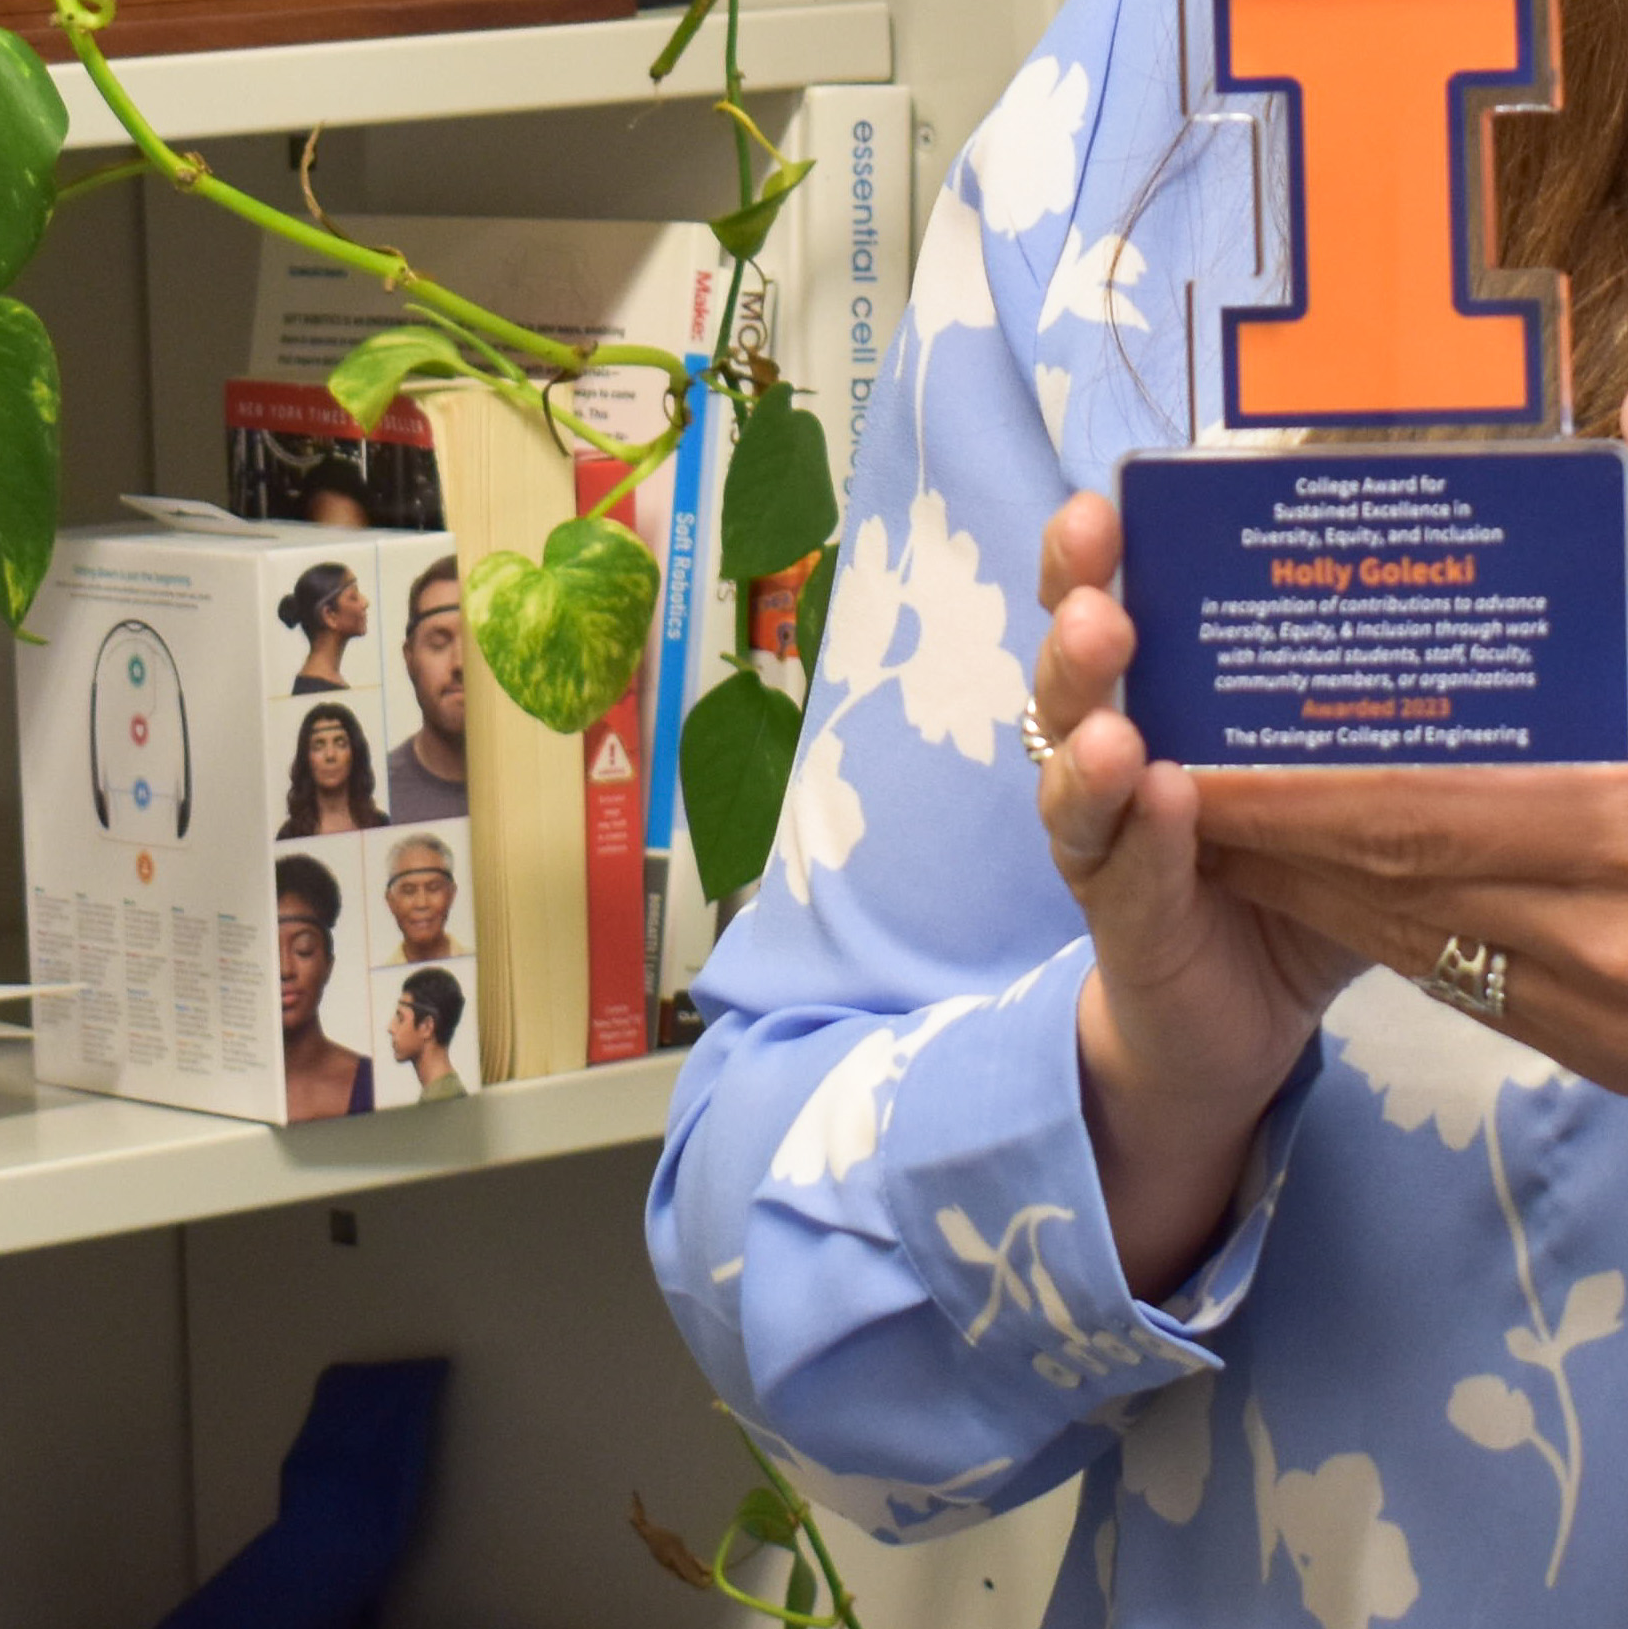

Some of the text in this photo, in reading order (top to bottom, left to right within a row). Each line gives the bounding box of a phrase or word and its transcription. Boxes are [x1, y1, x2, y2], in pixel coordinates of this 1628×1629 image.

[852, 120, 879, 283] essential
[691, 270, 713, 342] Make:
[851, 295, 879, 363] cell
[269, 403, 304, 421] YORK
[309, 406, 348, 425] TIMES
[1295, 474, 1445, 499] College Award for
[1273, 500, 1471, 522] Sustained Excellence in
[1241, 524, 1503, 549] Diversity, Equity, and Inclusion
[667, 511, 696, 641] Soft Robotics
[1273, 555, 1474, 593] Holly Golecki
[1202, 594, 1546, 618] in recognition of contributions to advance
[1199, 619, 1548, 643] Diversity, Equity, & Inclusion through work
[1218, 643, 1530, 666] with individual students, staff, faculty,
[1215, 669, 1535, 693] community members, or organizations
[1303, 699, 1395, 719] Awarded
[1225, 724, 1529, 749] The Grainger College of Engineering
